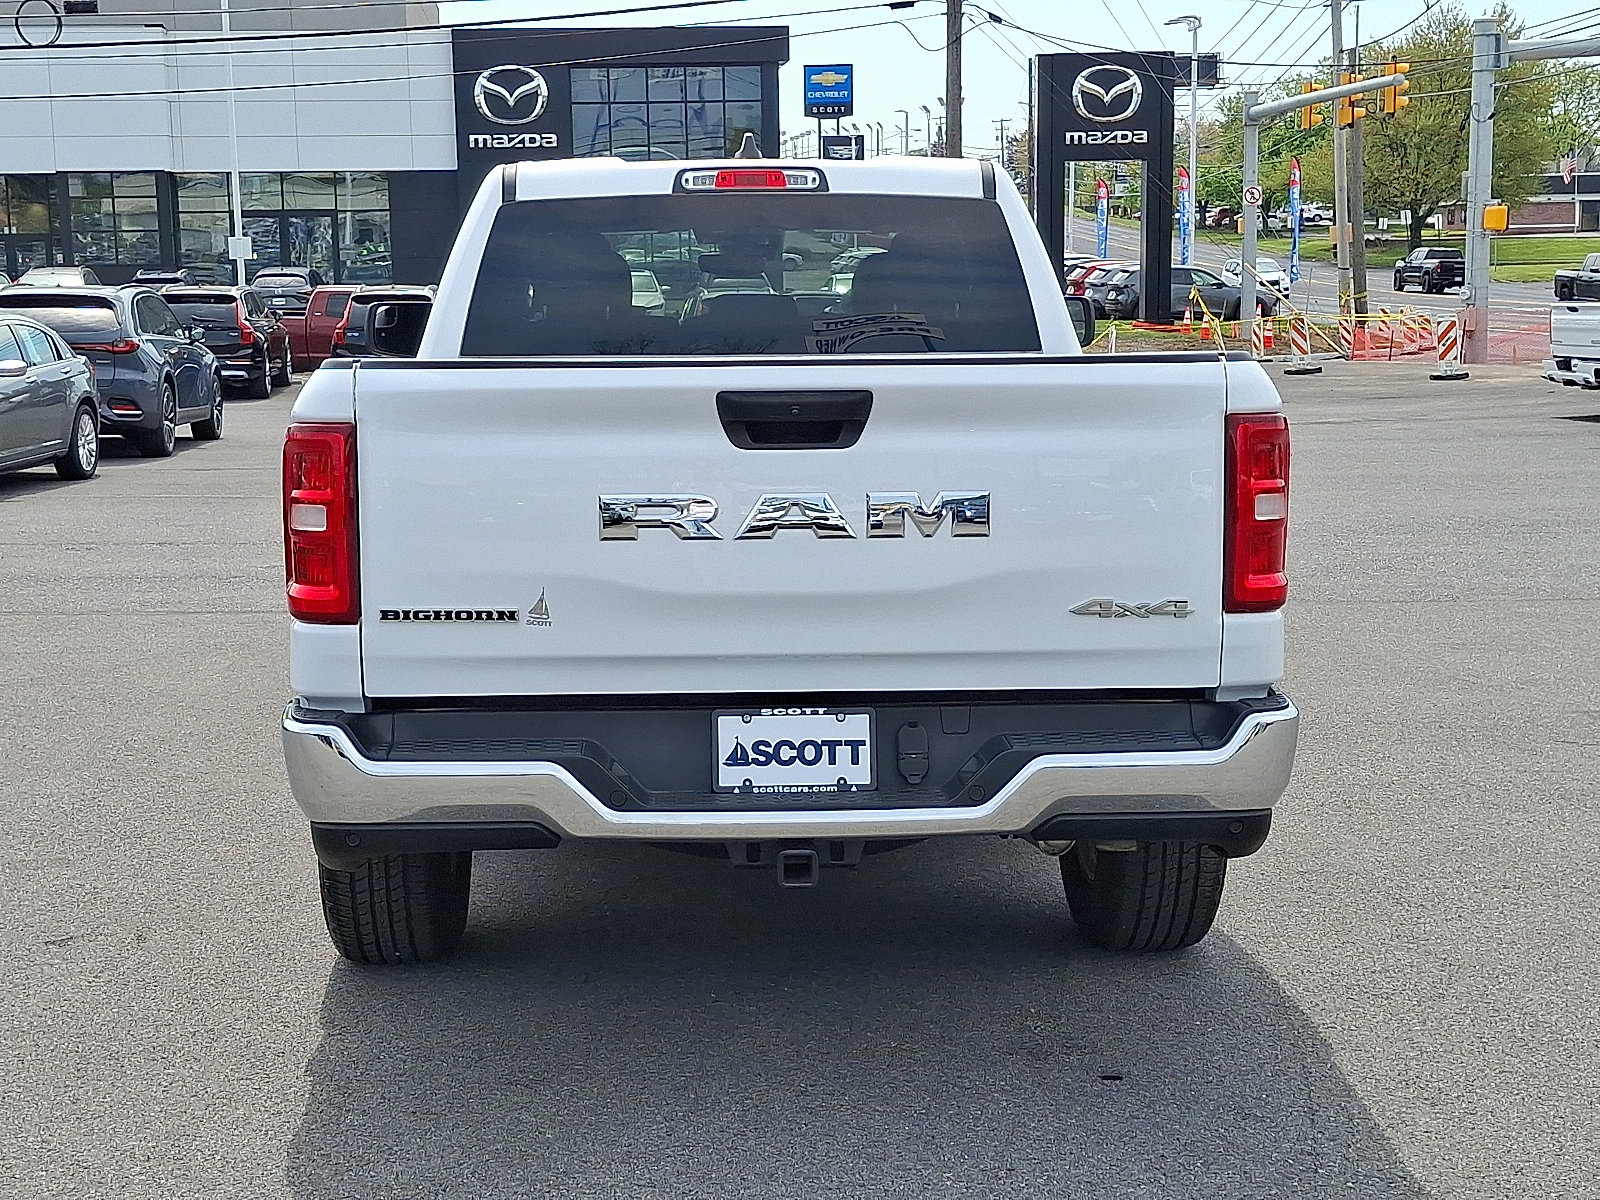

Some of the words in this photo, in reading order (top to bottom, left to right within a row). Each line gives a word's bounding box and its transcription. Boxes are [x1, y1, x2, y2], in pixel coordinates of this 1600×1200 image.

[598, 491, 991, 541] RAM
[379, 608, 519, 623] BIGHORN
[525, 619, 552, 627] SCOTT
[760, 707, 828, 716] SCOTT
[751, 739, 867, 767] SCOTT
[752, 785, 838, 794] scottcars.com
